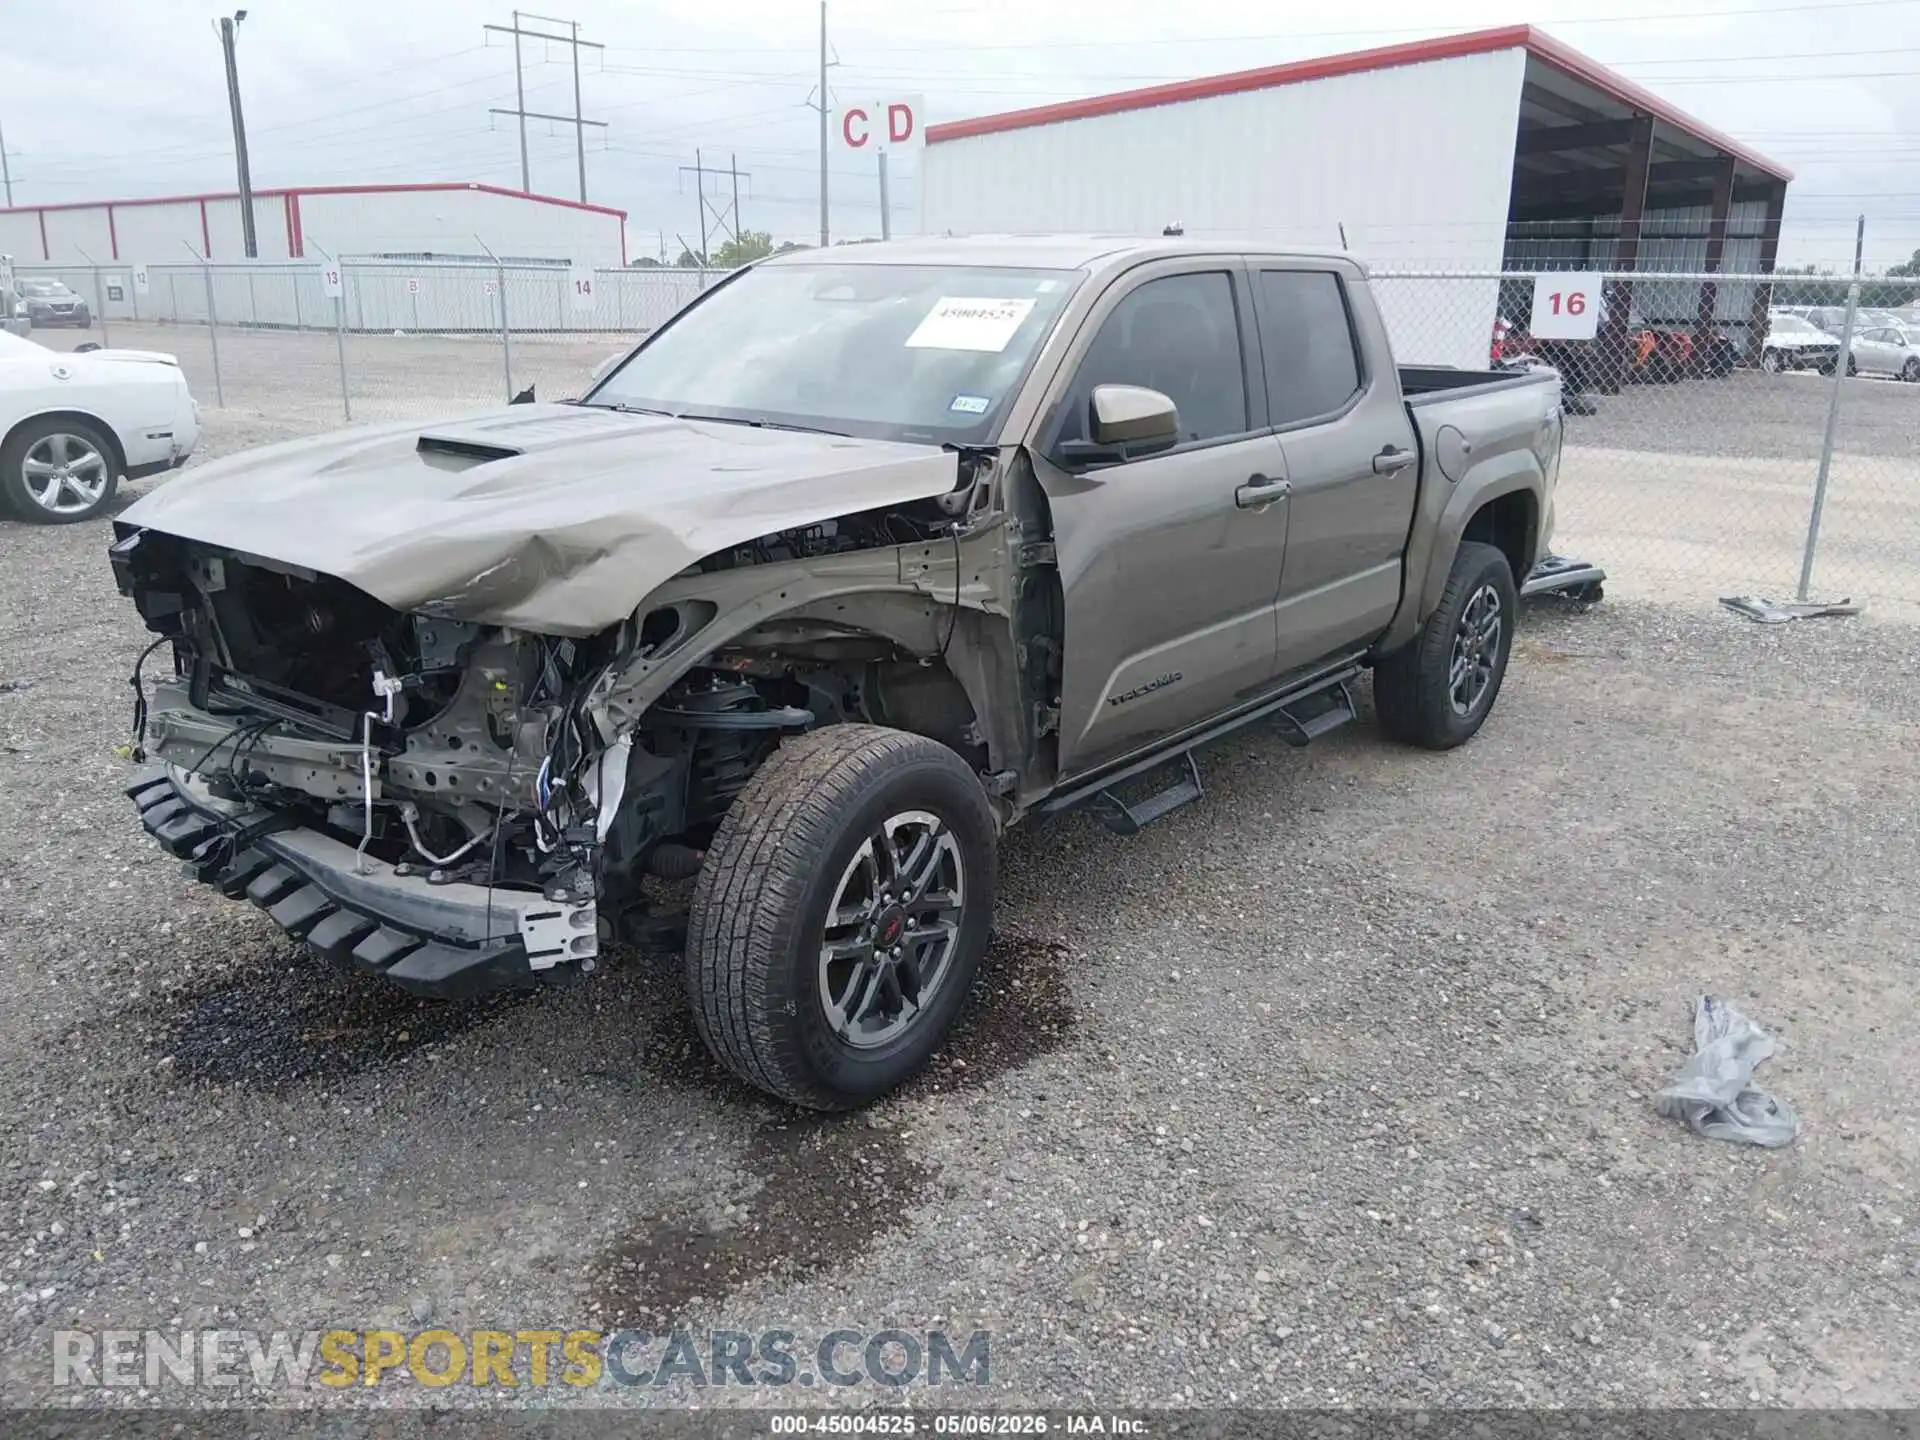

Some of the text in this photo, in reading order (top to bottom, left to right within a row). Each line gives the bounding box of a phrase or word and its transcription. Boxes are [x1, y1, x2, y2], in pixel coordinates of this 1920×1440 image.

[843, 103, 913, 148] C D
[326, 271, 338, 285] 13
[576, 280, 591, 295] 14
[1549, 292, 1586, 316] 16
